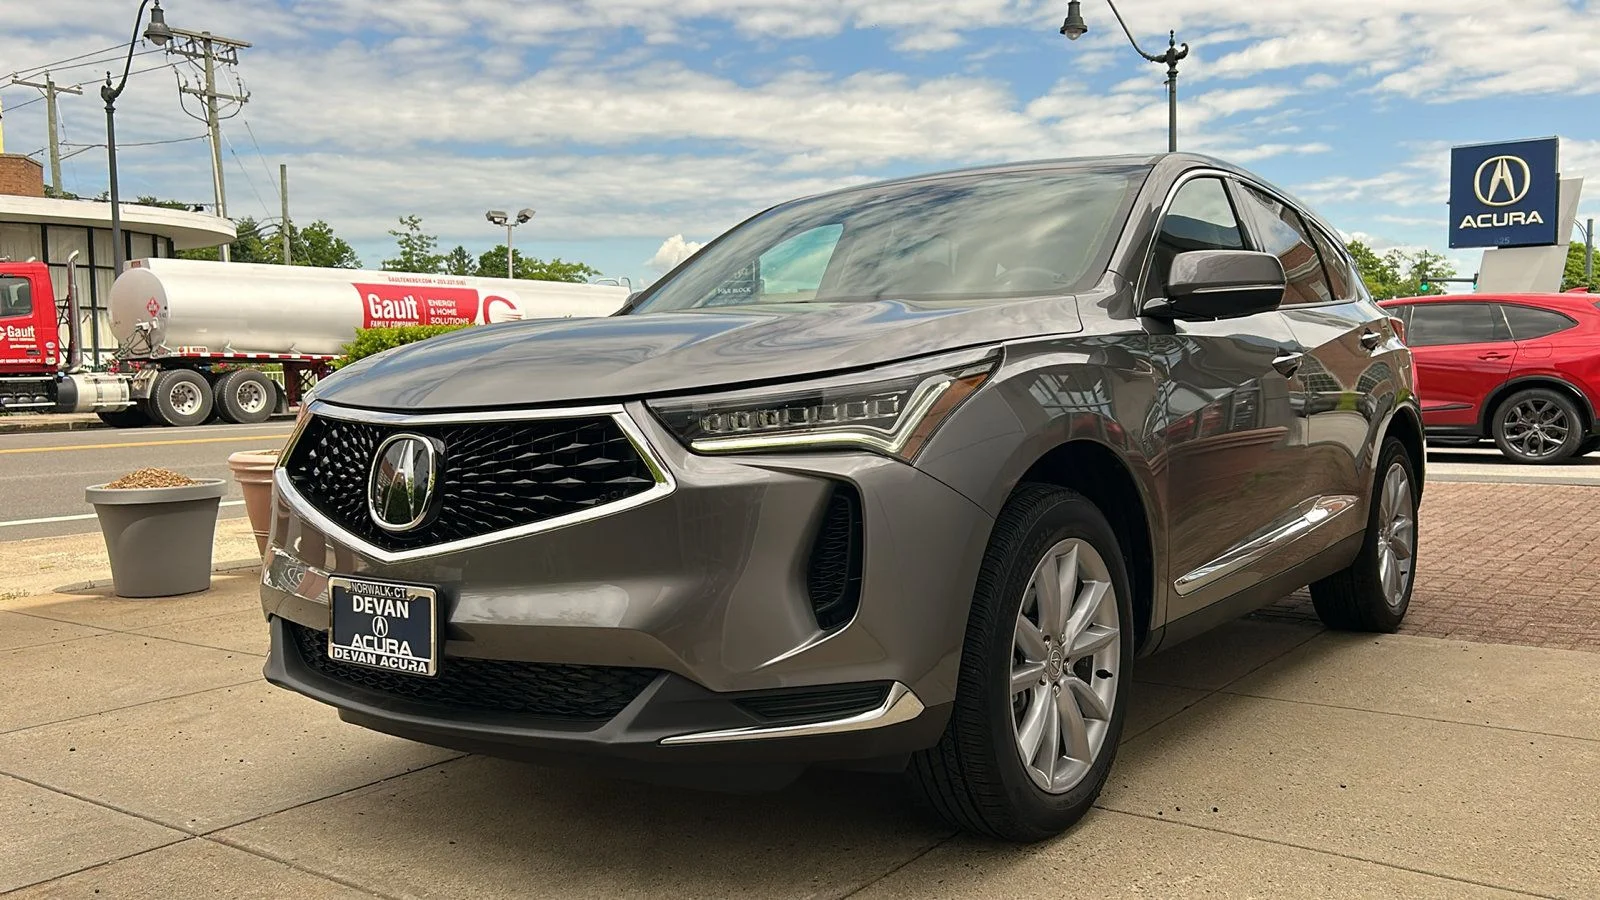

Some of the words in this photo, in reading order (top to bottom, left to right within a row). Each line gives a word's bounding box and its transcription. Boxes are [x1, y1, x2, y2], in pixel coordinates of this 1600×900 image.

[1459, 210, 1544, 230] ACURA
[367, 294, 419, 319] Gault
[428, 299, 455, 307] ENERGY
[7, 325, 35, 338] Gault
[352, 595, 409, 619] DEVAN
[351, 634, 413, 658] ACURA
[334, 647, 376, 665] DEVAN
[380, 656, 428, 673] ACURA
